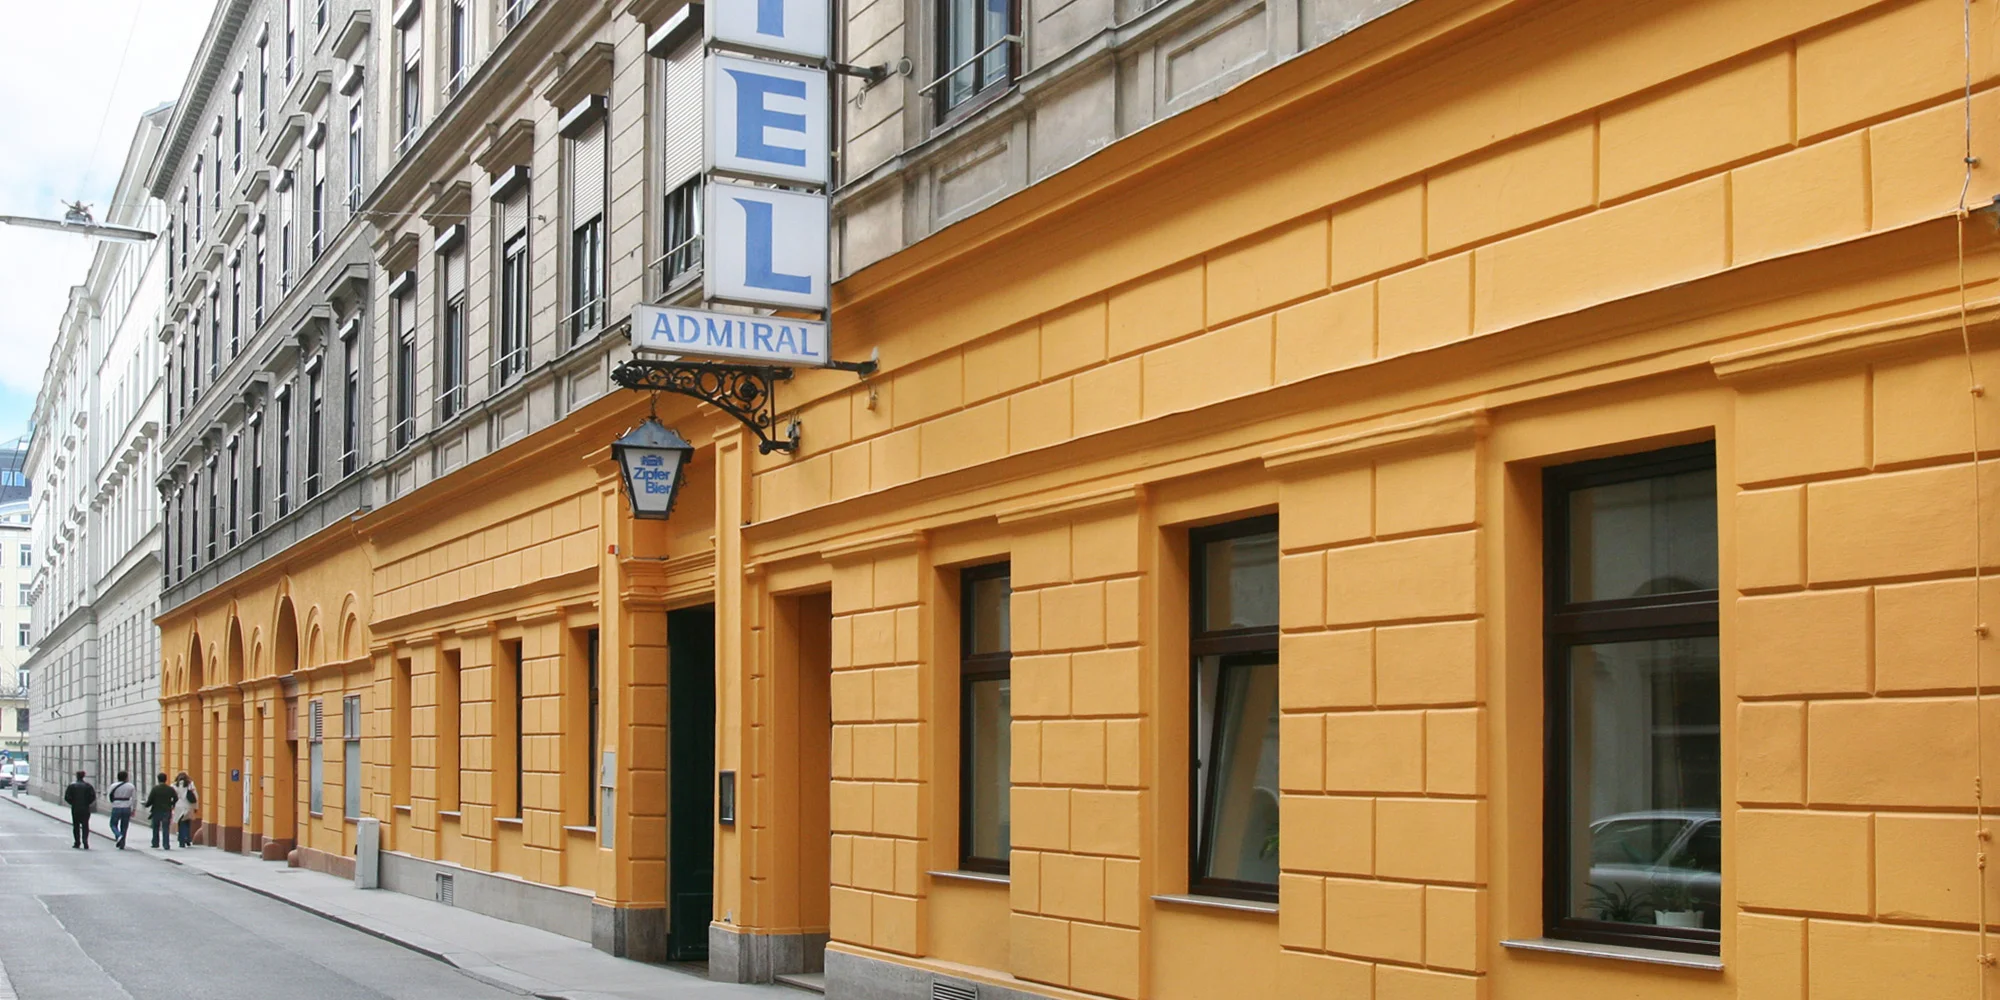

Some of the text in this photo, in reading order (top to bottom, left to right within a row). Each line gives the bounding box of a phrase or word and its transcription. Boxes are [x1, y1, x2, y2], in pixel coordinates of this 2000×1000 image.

[651, 312, 819, 357] ADMIRAL
[633, 466, 671, 480] Zipfer
[646, 481, 672, 494] Bier
